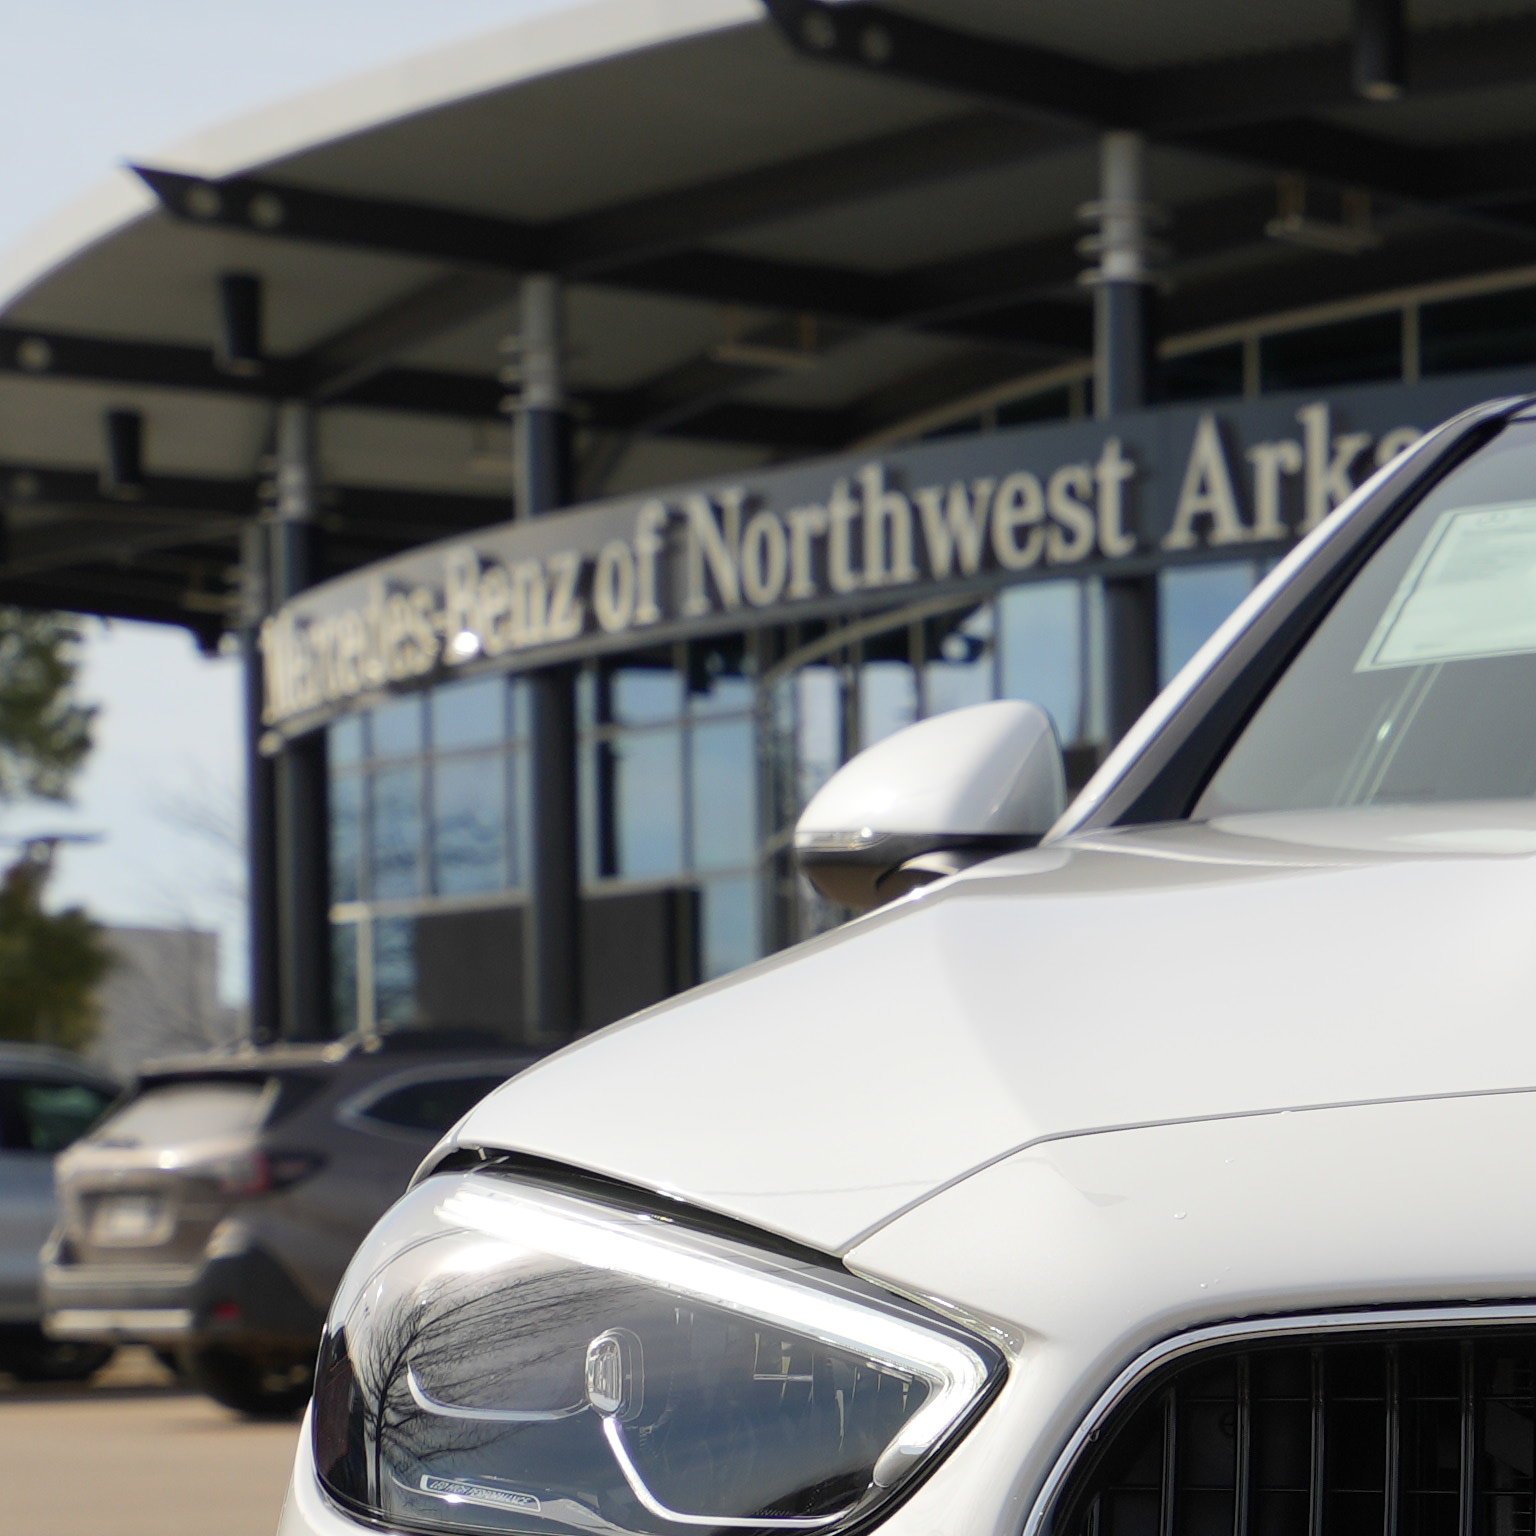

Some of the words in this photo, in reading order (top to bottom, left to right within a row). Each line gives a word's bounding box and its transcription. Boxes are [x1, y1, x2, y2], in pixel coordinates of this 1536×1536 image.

[261, 546, 583, 727] Mercedes-Benz
[594, 501, 667, 633] of
[684, 437, 1137, 618] Northwest
